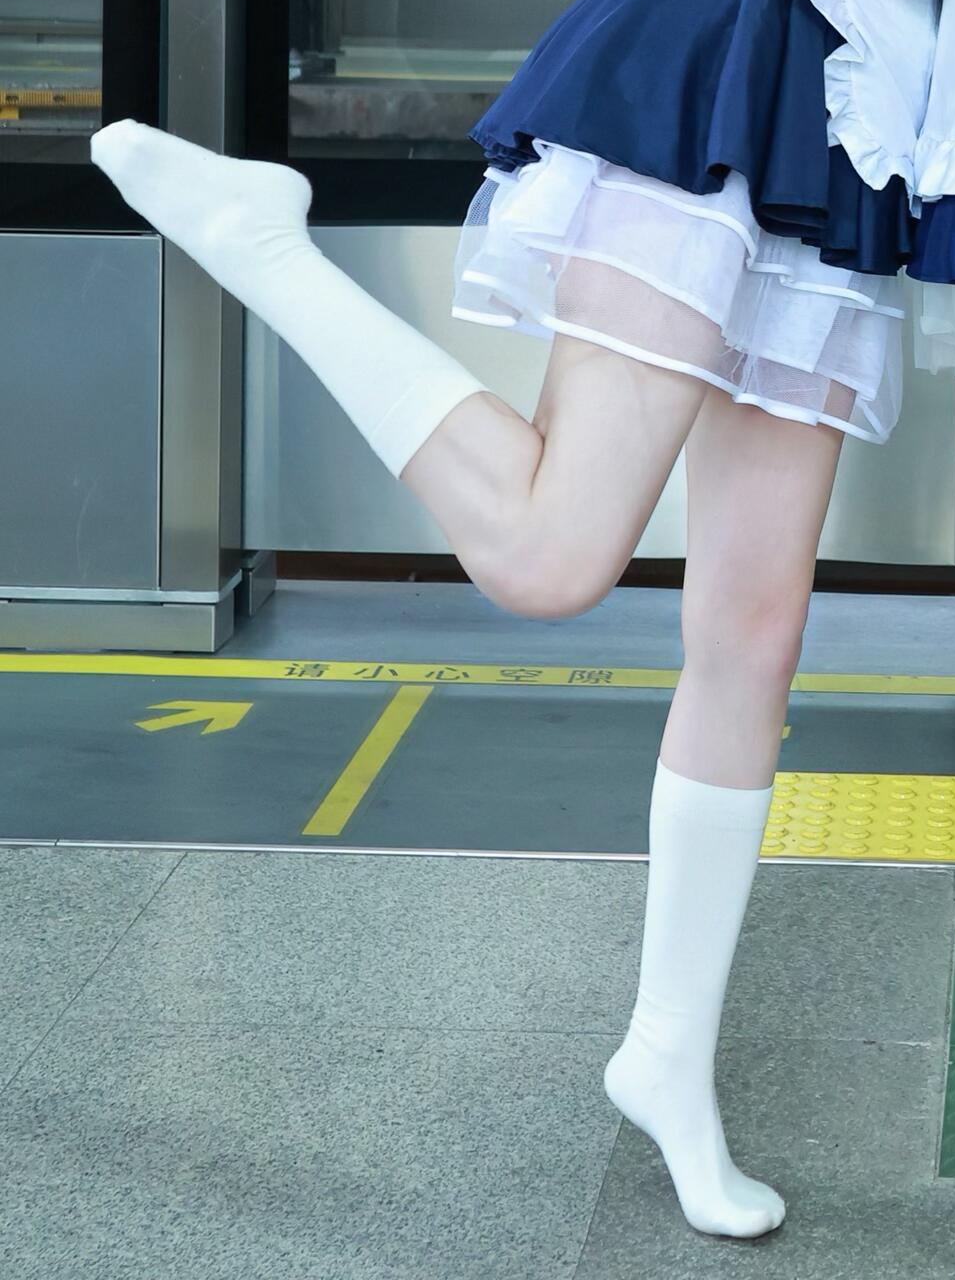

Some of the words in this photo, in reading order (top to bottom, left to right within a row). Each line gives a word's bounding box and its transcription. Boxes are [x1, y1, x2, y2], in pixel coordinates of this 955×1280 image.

[284, 662, 614, 684] 请小心空隙
